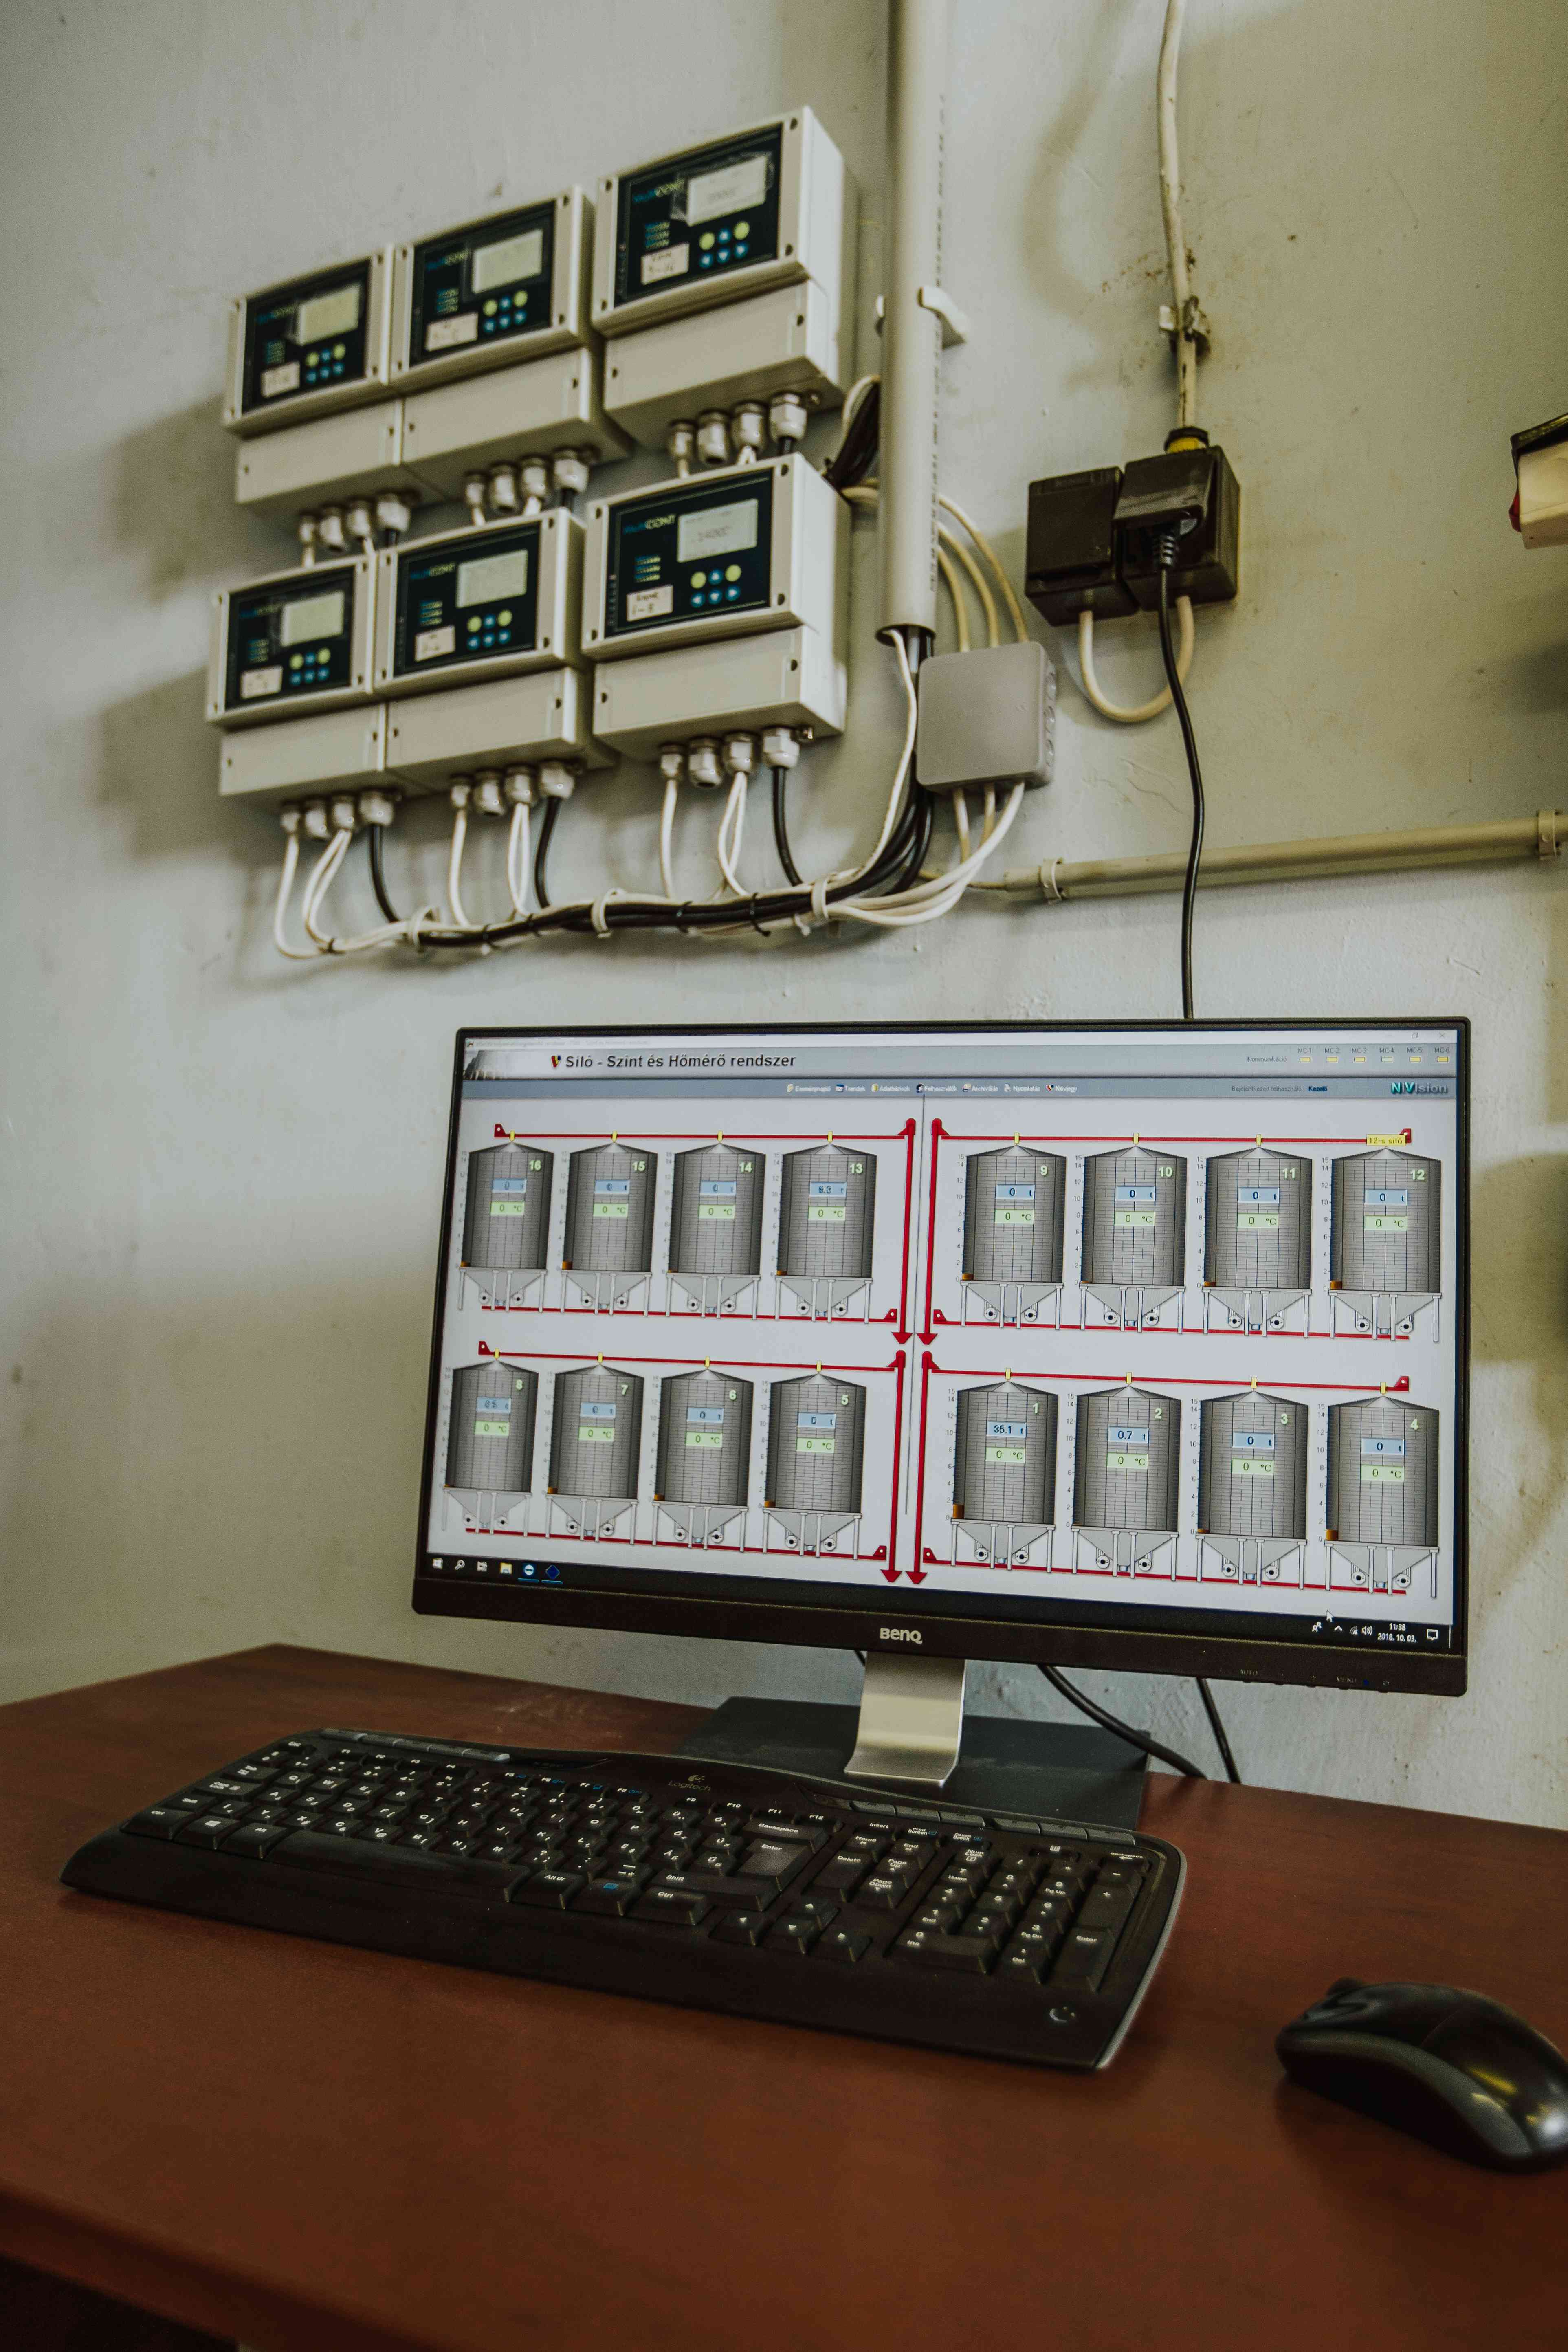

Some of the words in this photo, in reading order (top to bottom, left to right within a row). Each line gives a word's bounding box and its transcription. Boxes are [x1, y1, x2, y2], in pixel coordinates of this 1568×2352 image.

[566, 1055, 593, 1067] Siló
[607, 1055, 642, 1067] Szint
[648, 1055, 663, 1067] és
[669, 1054, 725, 1067] Hőmérő
[730, 1054, 796, 1067] rendszer
[1391, 1082, 1448, 1094] NiVision
[529, 1160, 541, 1171] 16
[633, 1160, 645, 1171] 15
[739, 1162, 752, 1173] 14
[849, 1163, 863, 1174] 13
[1040, 1165, 1048, 1176] 9
[1159, 1166, 1173, 1177] 10
[1282, 1168, 1295, 1179] 11
[1410, 1170, 1425, 1180] 12
[1009, 1188, 1015, 1196] 0
[1130, 1190, 1135, 1198] 0
[1253, 1192, 1258, 1200] 0
[1380, 1193, 1385, 1201] 0
[516, 1379, 523, 1390] 8
[621, 1384, 628, 1395] 7
[729, 1390, 737, 1400] 6
[841, 1394, 849, 1405] 5
[1033, 1403, 1038, 1413] 1
[1155, 1408, 1162, 1419] 2
[1280, 1413, 1288, 1424] 3
[994, 1425, 1012, 1434] 35.1
[1410, 1419, 1418, 1430] 4
[1118, 1430, 1133, 1439] 0.7
[1247, 1437, 1254, 1445] 0
[1377, 1442, 1383, 1450] 0
[1243, 1463, 1249, 1471] 0
[1372, 1469, 1378, 1477] 0
[880, 1628, 923, 1644] BenQ
[668, 1780, 711, 1791] Logitech
[758, 1823, 798, 1833] Backspace
